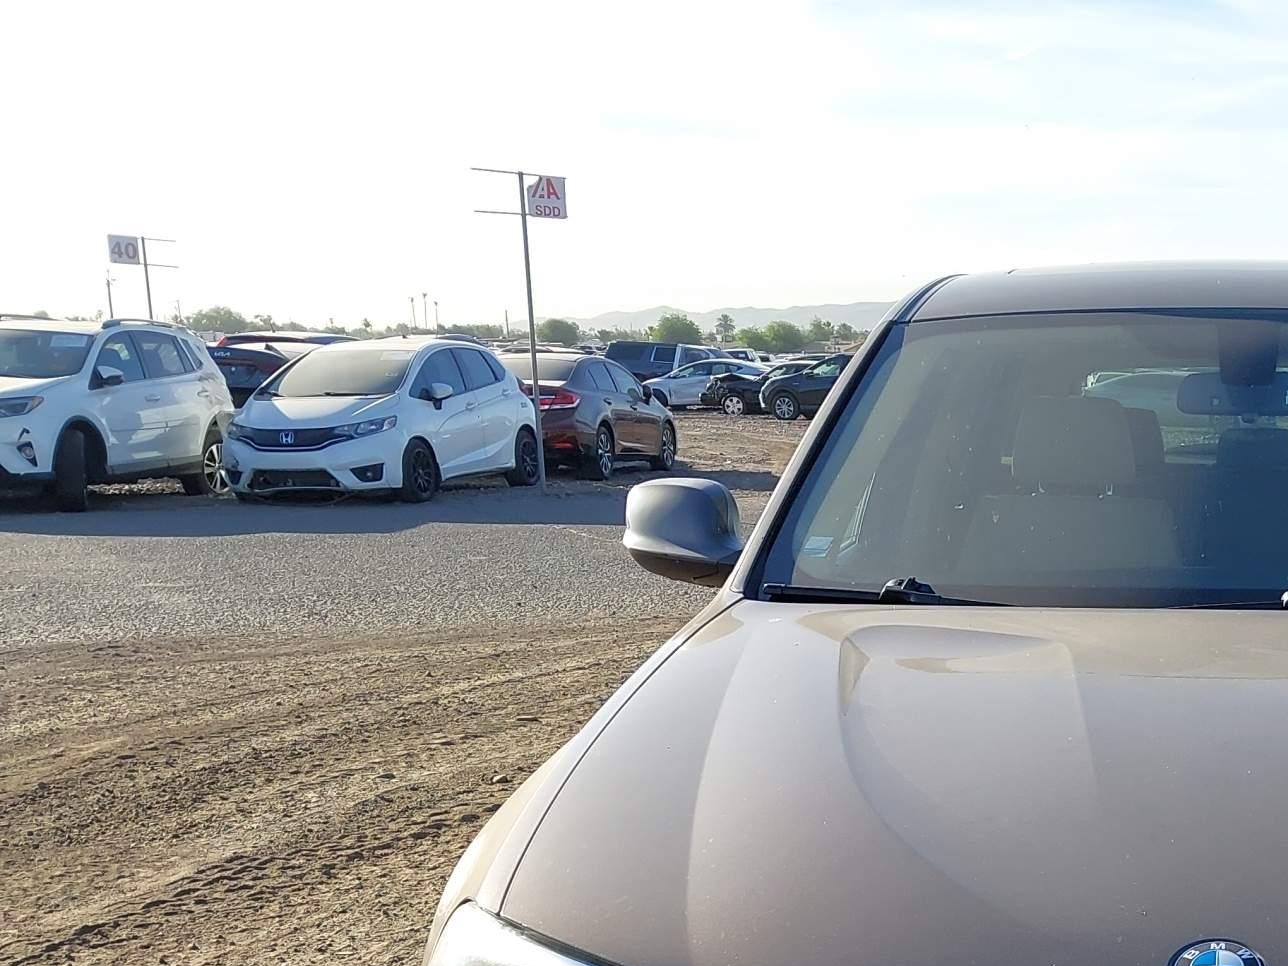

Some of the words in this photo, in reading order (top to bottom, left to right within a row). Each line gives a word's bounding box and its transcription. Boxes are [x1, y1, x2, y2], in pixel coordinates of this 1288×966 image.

[535, 205, 561, 217] SDD
[111, 241, 137, 260] 40
[1182, 942, 1256, 960] BMW
